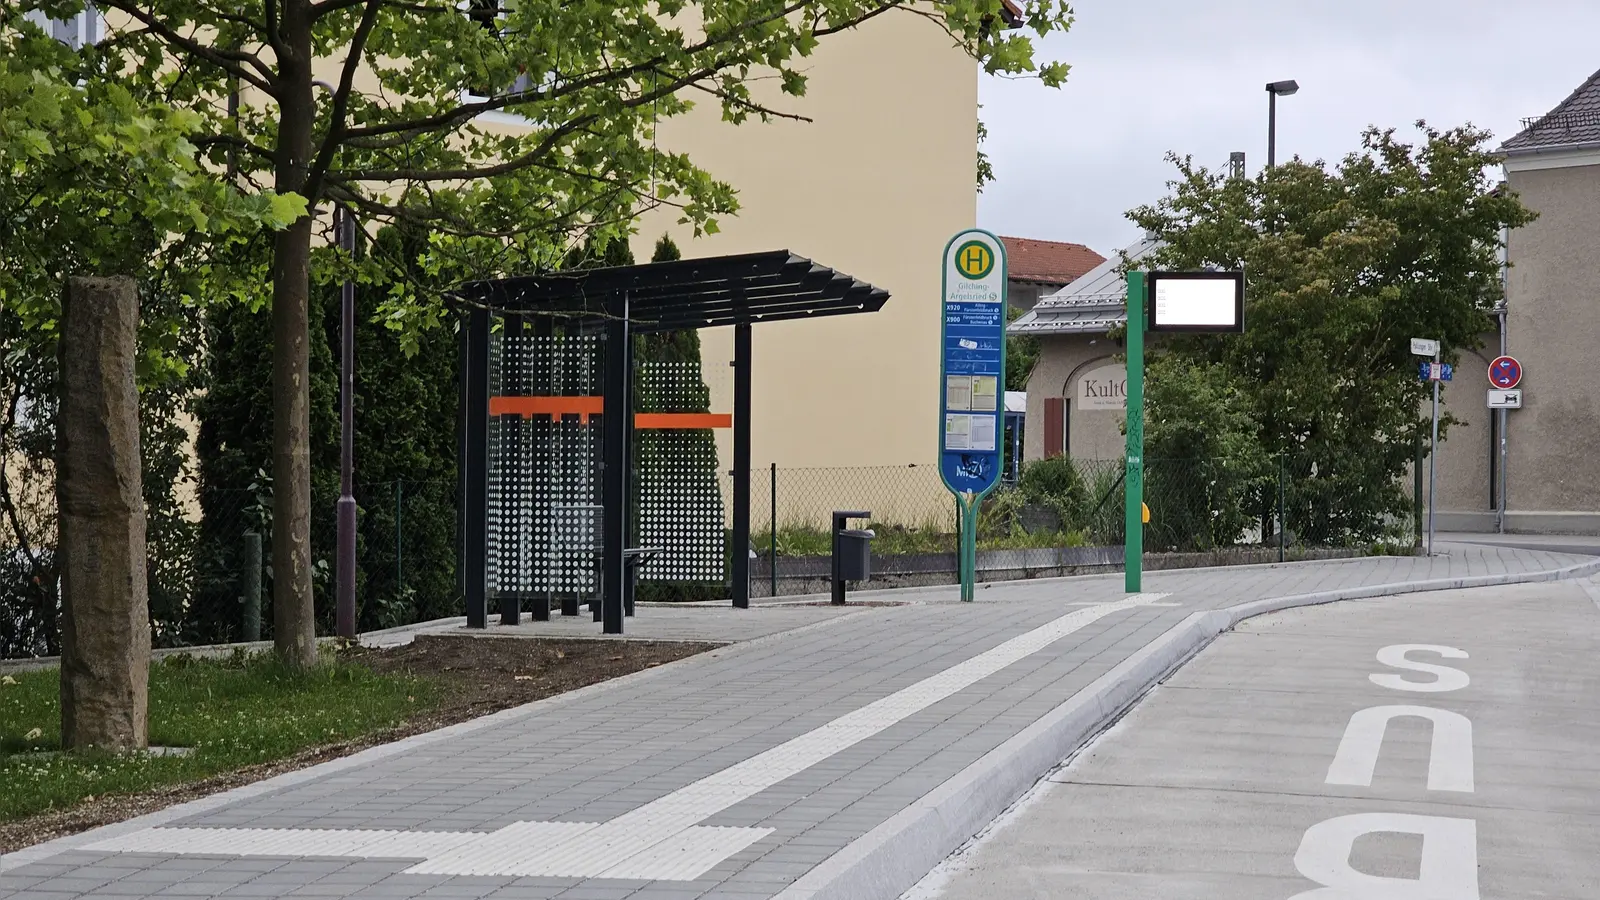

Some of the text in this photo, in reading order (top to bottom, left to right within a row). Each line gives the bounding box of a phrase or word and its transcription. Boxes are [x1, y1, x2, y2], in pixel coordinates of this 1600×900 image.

[966, 248, 983, 272] H
[958, 282, 990, 291] Gilching-
[950, 292, 987, 301] Argelsried
